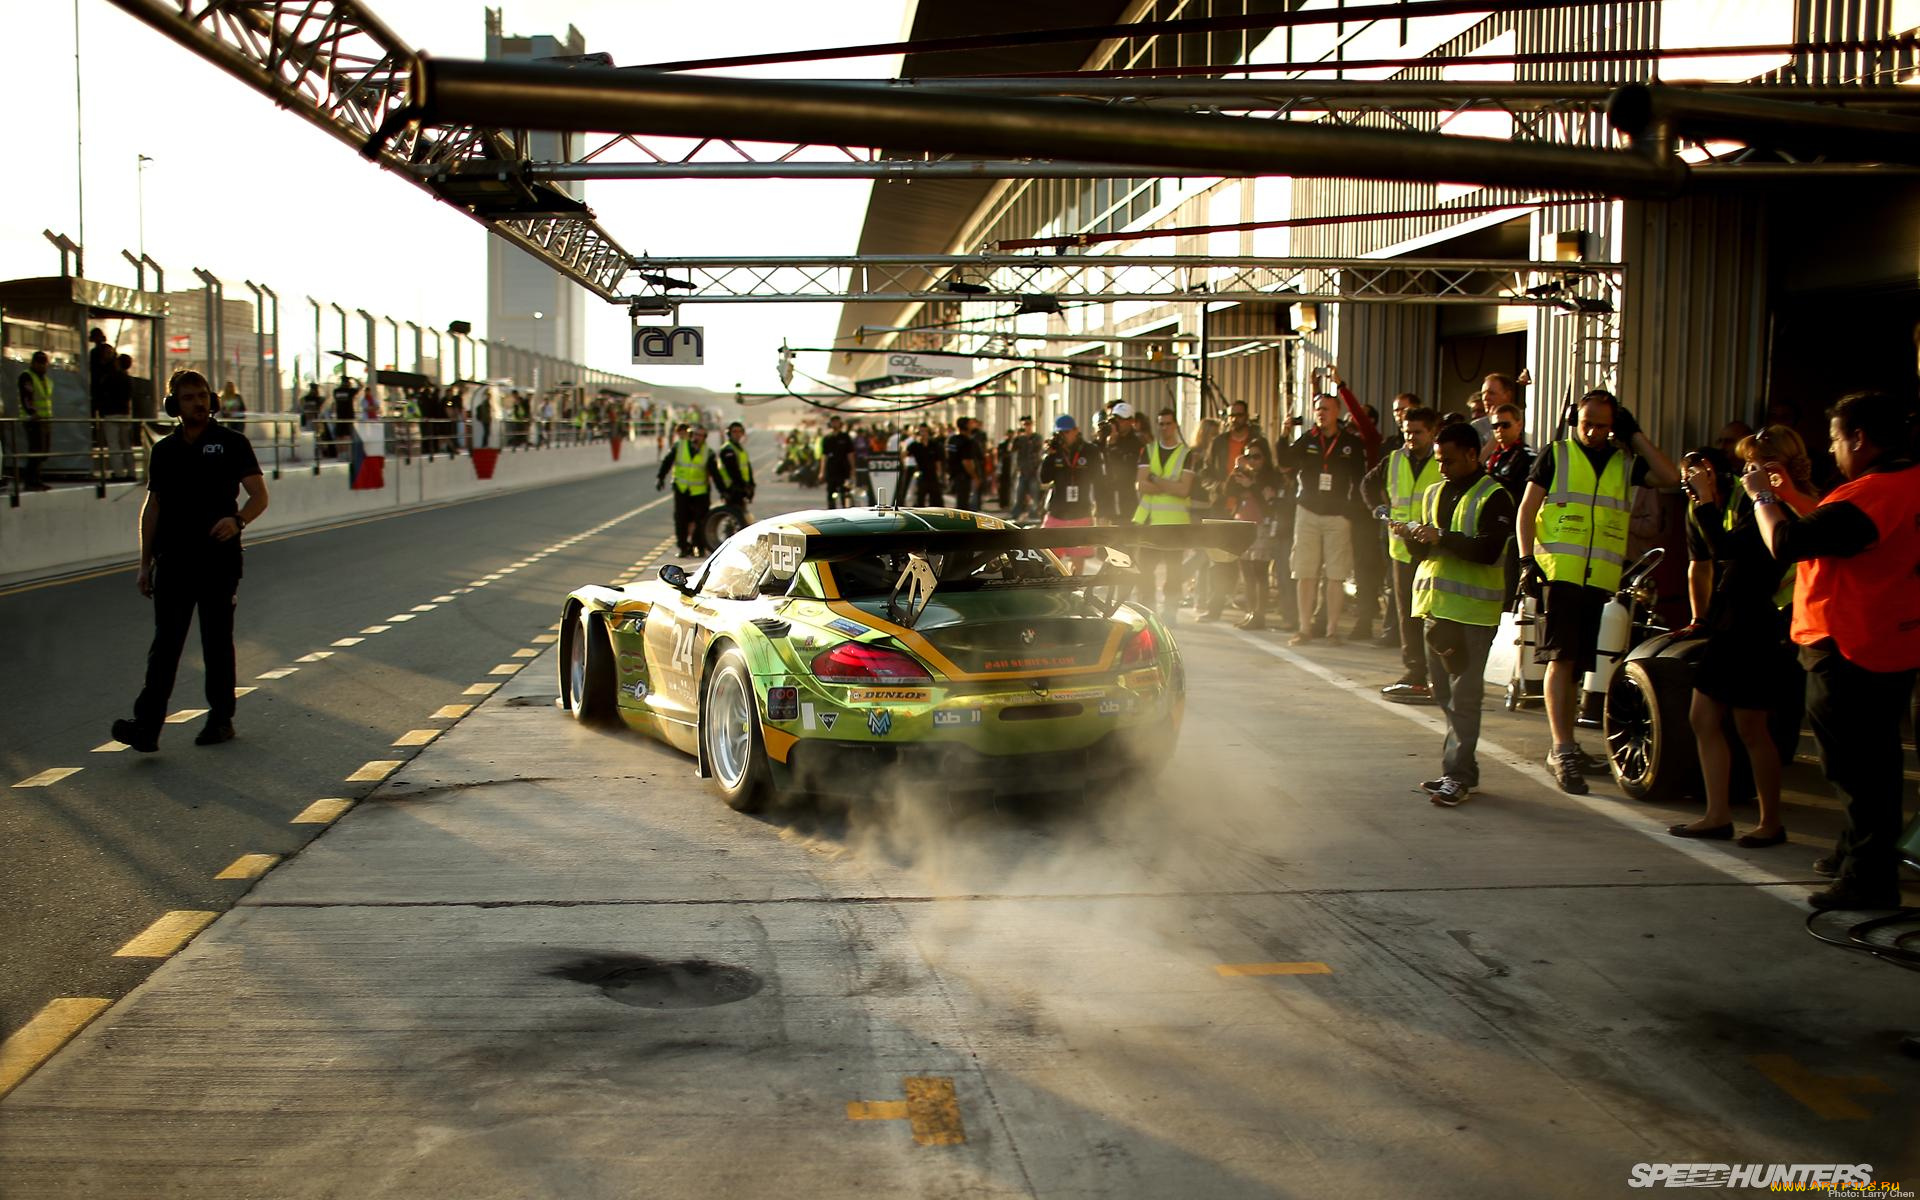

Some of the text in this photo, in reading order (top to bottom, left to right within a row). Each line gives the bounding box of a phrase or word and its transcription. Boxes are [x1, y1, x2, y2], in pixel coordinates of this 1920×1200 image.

[633, 326, 703, 358] ram
[888, 354, 921, 368] GDL
[868, 459, 900, 470] STOP
[1014, 549, 1043, 562] 24
[671, 623, 694, 676] 24
[863, 690, 926, 700] DUNLOP
